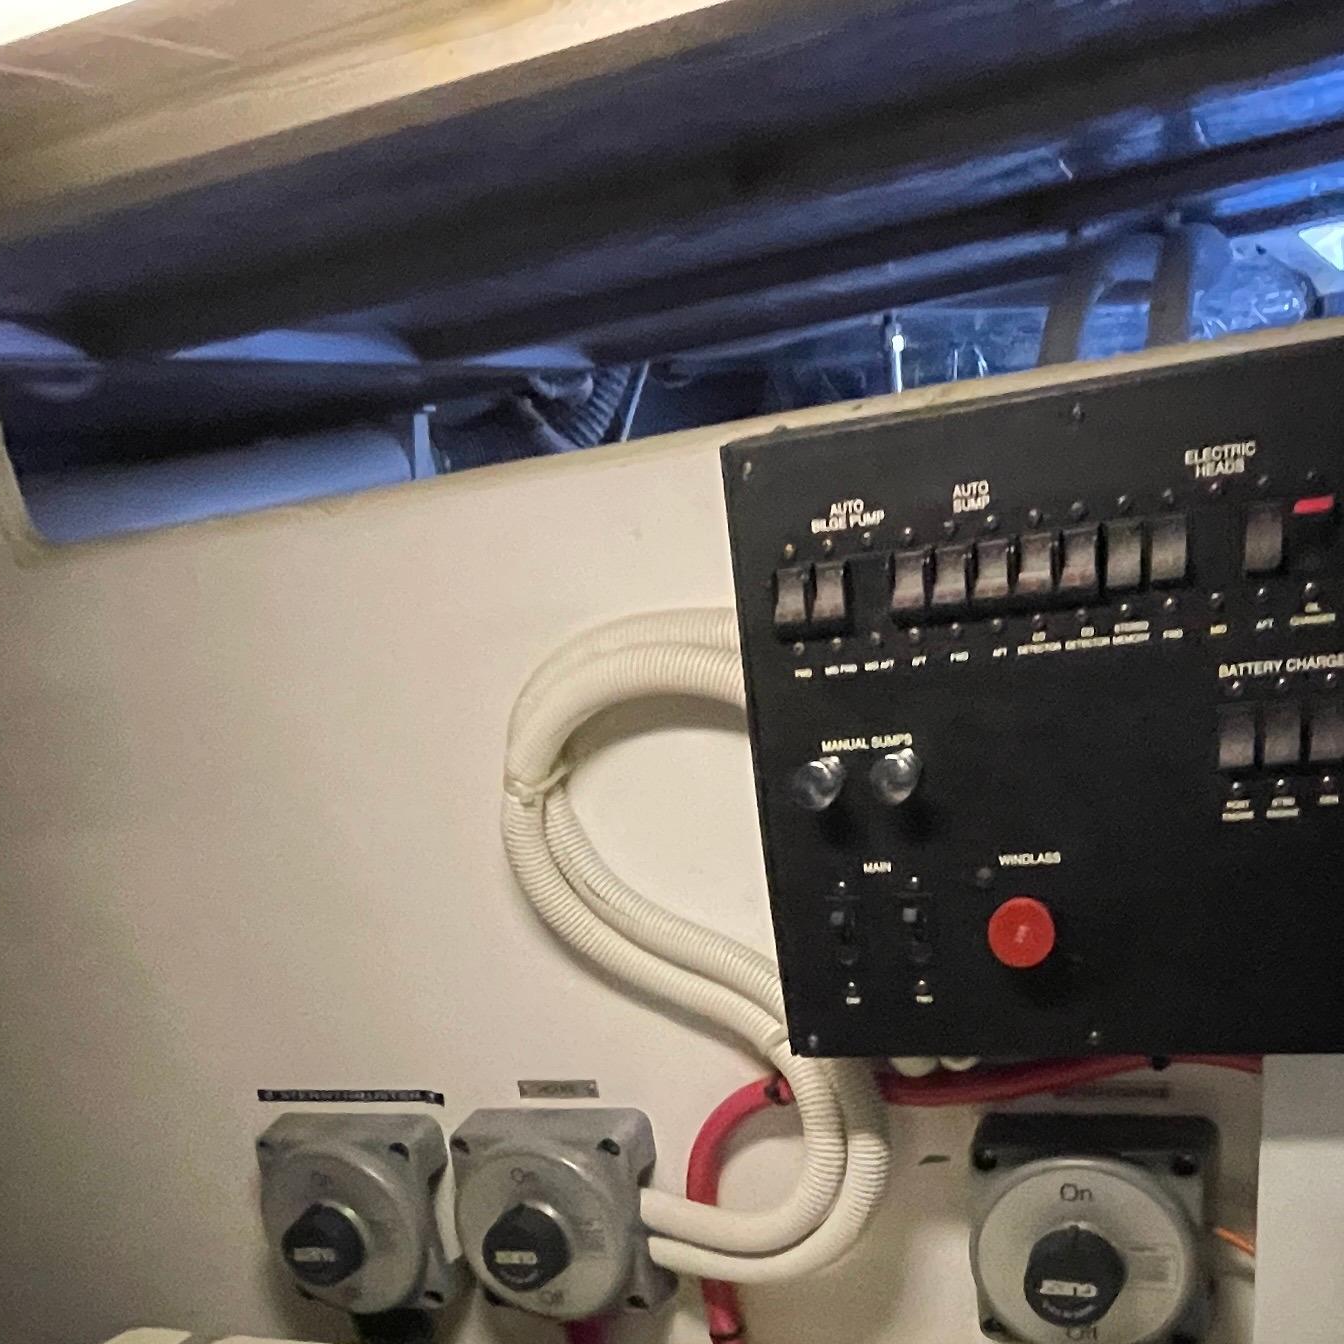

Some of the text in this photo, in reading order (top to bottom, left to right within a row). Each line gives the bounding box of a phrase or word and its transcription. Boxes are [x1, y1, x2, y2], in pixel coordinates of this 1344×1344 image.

[1185, 440, 1256, 466] ELECTRIC
[1195, 459, 1245, 478] HEADS
[953, 480, 990, 499] AUTO
[829, 498, 865, 517] AUTO
[811, 508, 885, 534] BILGE PUMP
[1219, 660, 1283, 679] BATTERY
[821, 737, 869, 752] MANUAL
[863, 861, 892, 874] MAIN
[999, 851, 1061, 866] WINDLASS
[1060, 1183, 1093, 1202] On
